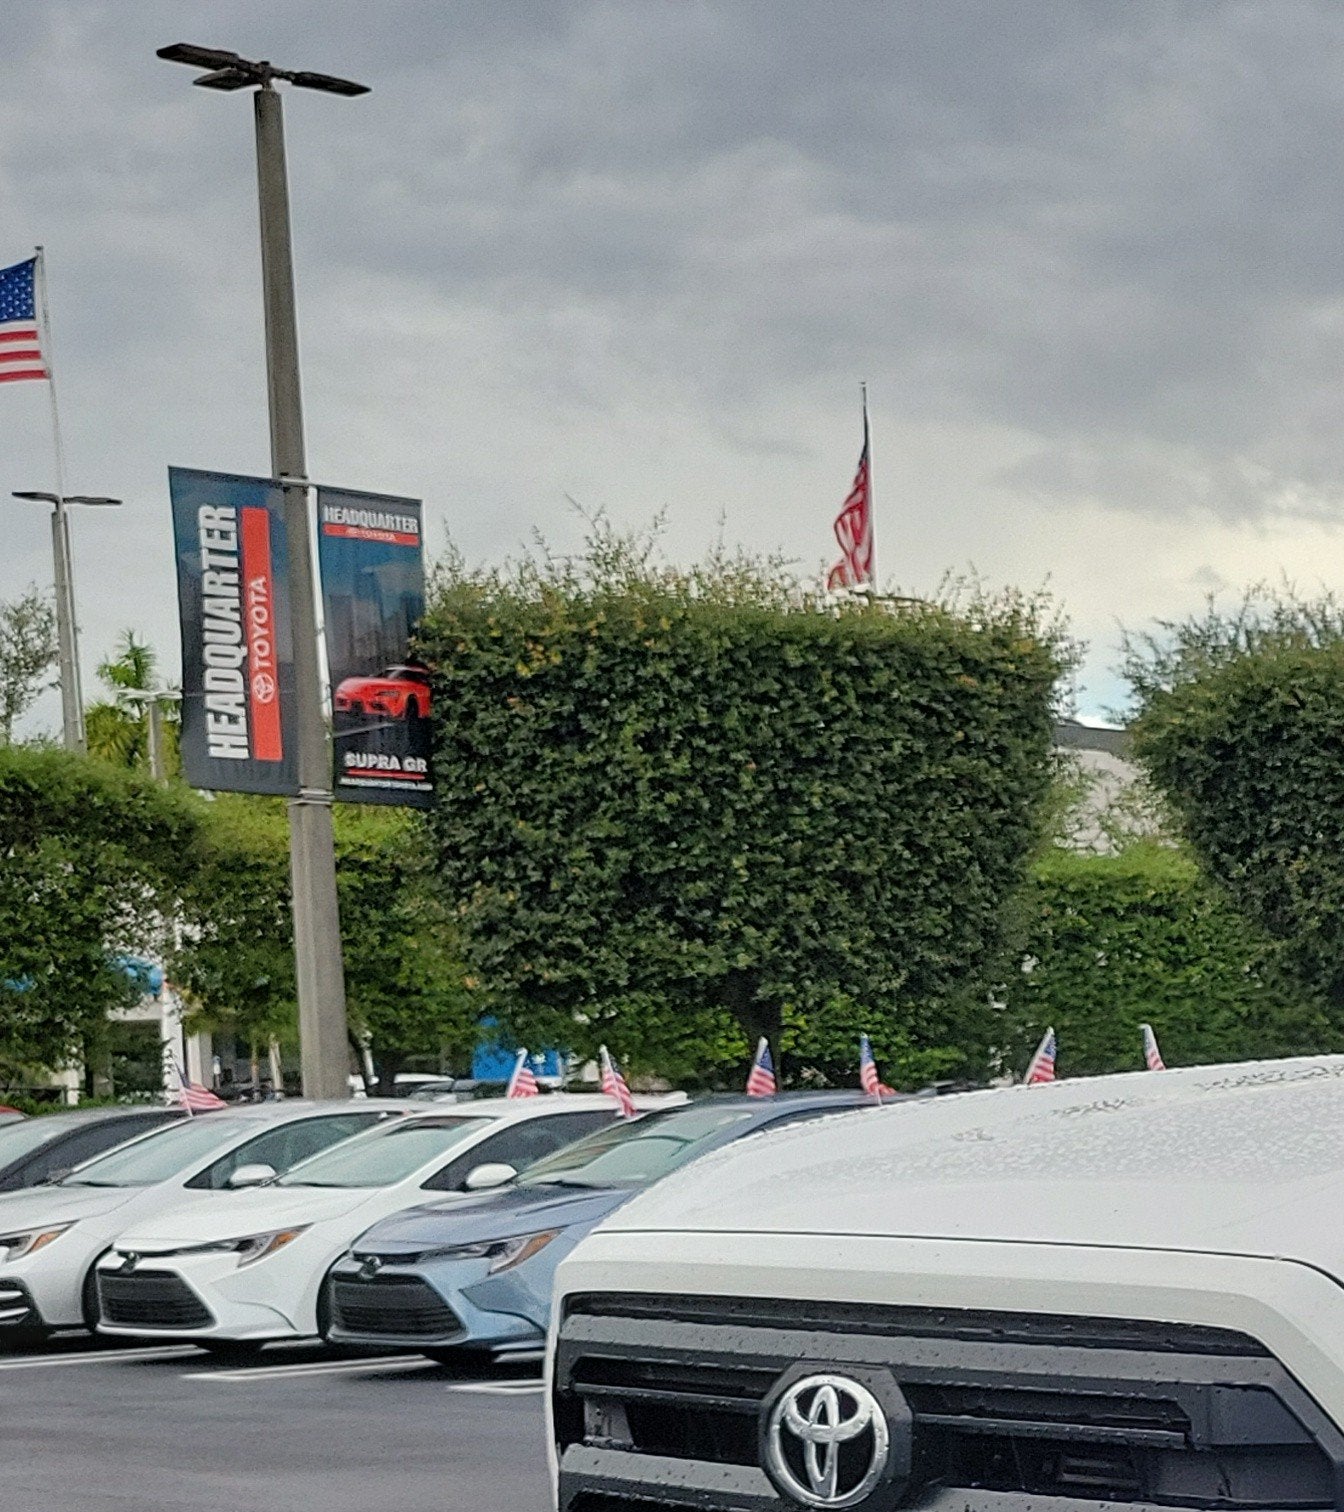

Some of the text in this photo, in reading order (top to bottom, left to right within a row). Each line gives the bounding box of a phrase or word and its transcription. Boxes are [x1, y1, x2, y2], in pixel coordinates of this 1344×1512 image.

[322, 504, 419, 533] HEADQUARTER
[198, 504, 250, 760] HEADQUARTER
[250, 576, 274, 669] TOYOTA
[344, 751, 428, 772] SUPRA GR
